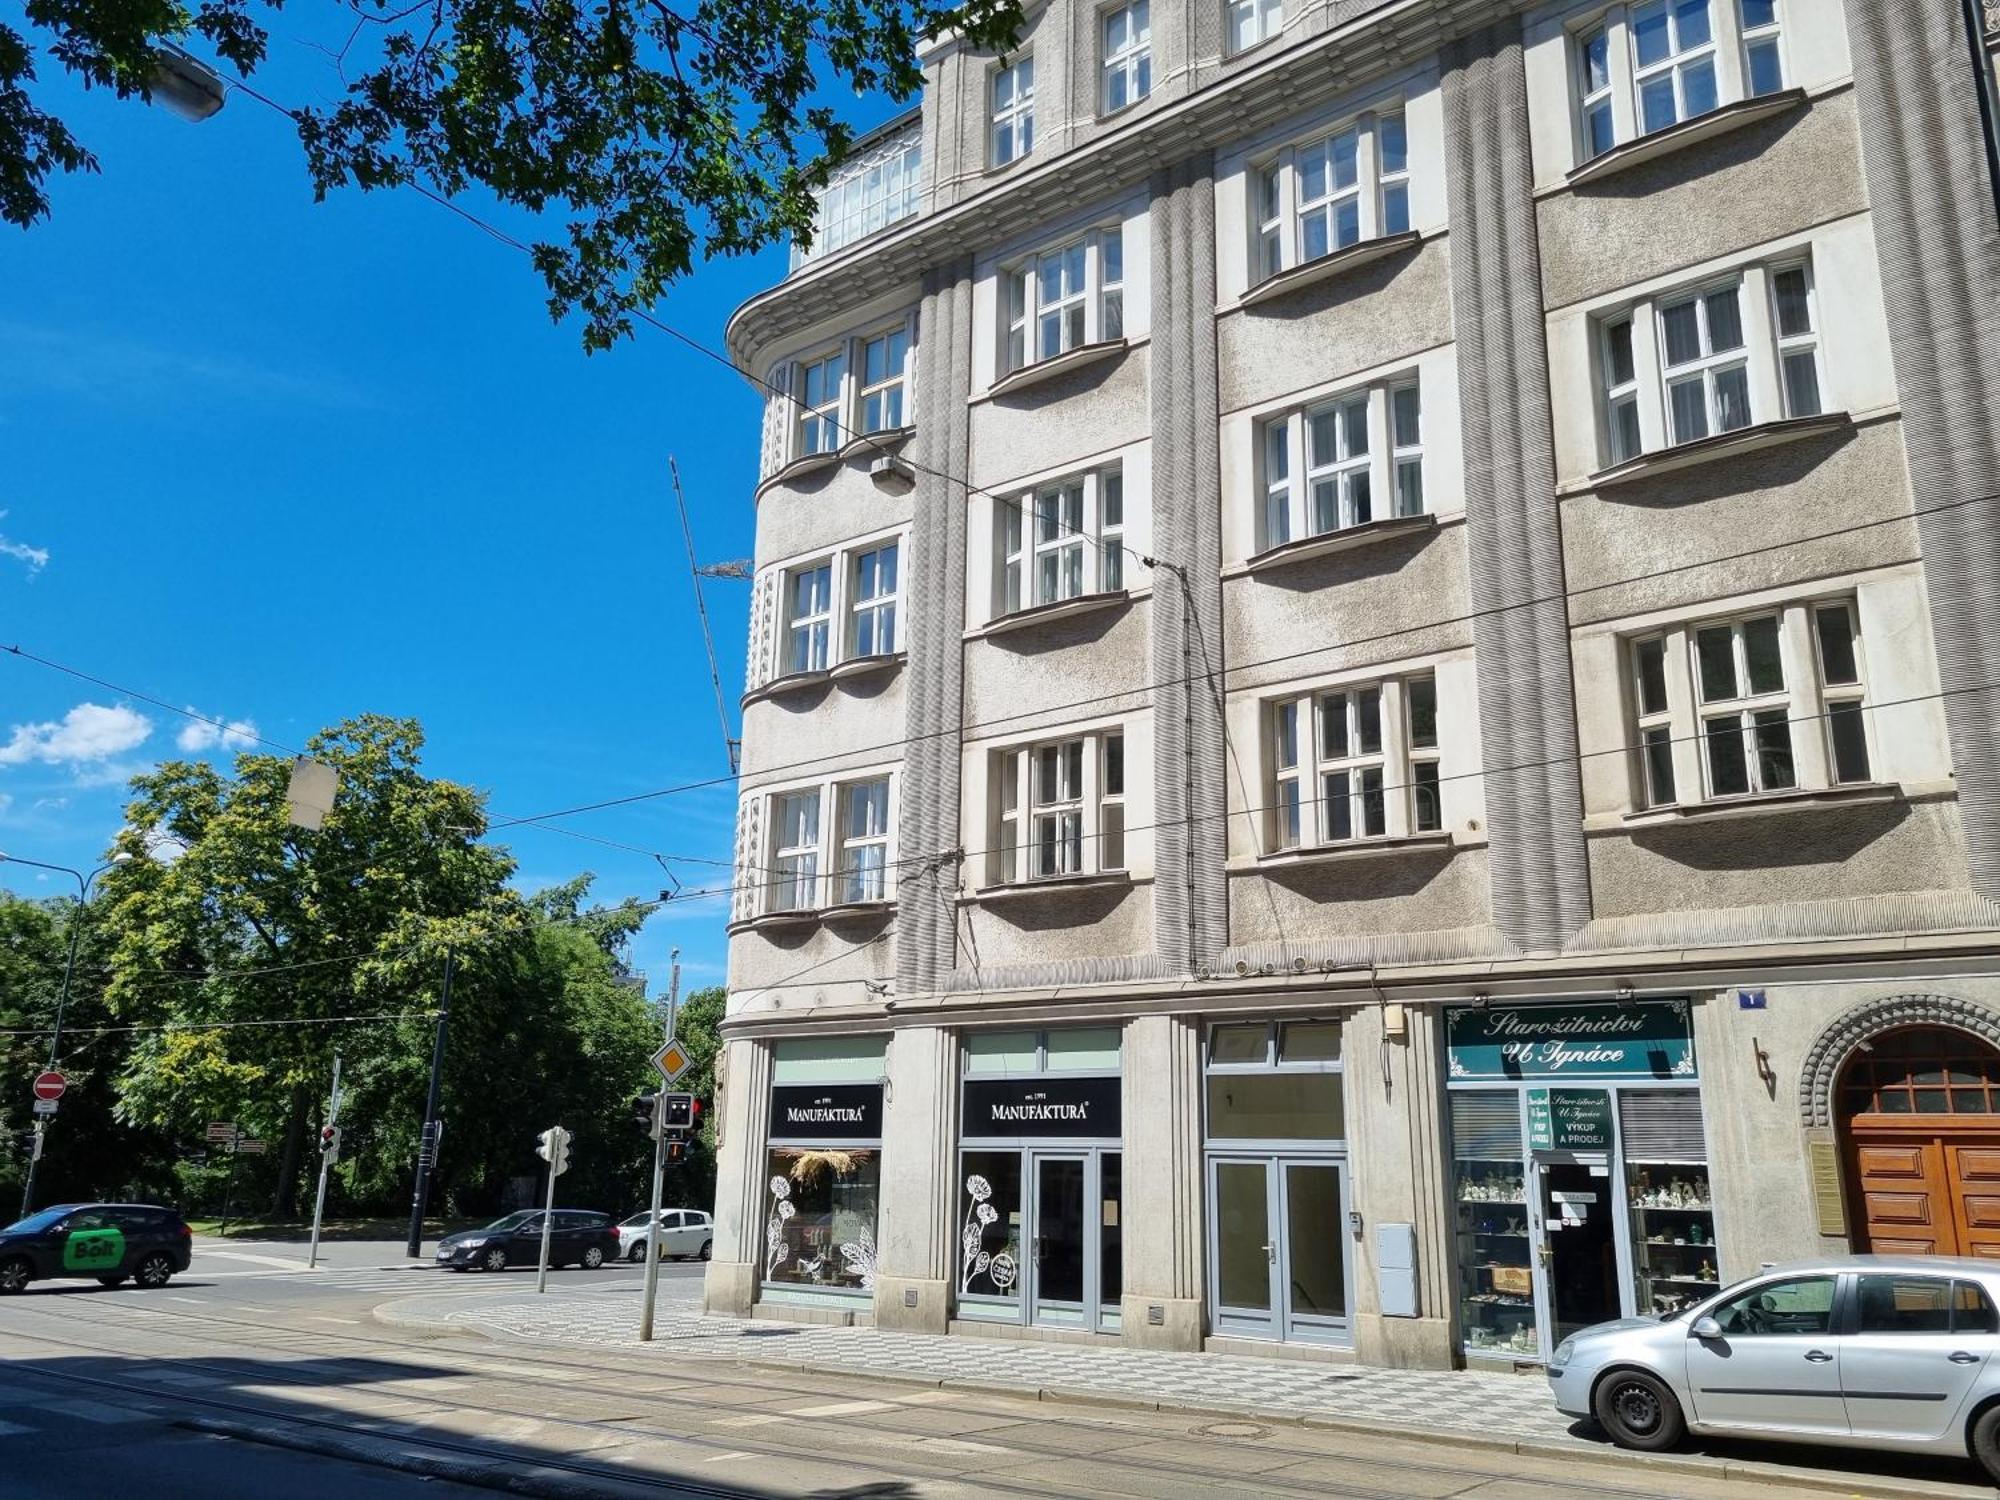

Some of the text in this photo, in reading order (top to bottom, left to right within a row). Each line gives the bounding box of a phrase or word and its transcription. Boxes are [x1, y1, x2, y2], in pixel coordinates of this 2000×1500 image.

[1483, 1011, 1647, 1036] Starožitnictví
[1502, 1040, 1625, 1070] U Ignáce
[787, 1107, 863, 1121] MANUFAKTURA
[991, 1103, 1087, 1120] MANUFAKTURA
[1566, 1121, 1596, 1131] VÝKUP
[1560, 1135, 1604, 1143] A PRODEJ
[74, 1240, 116, 1259] Bolt
